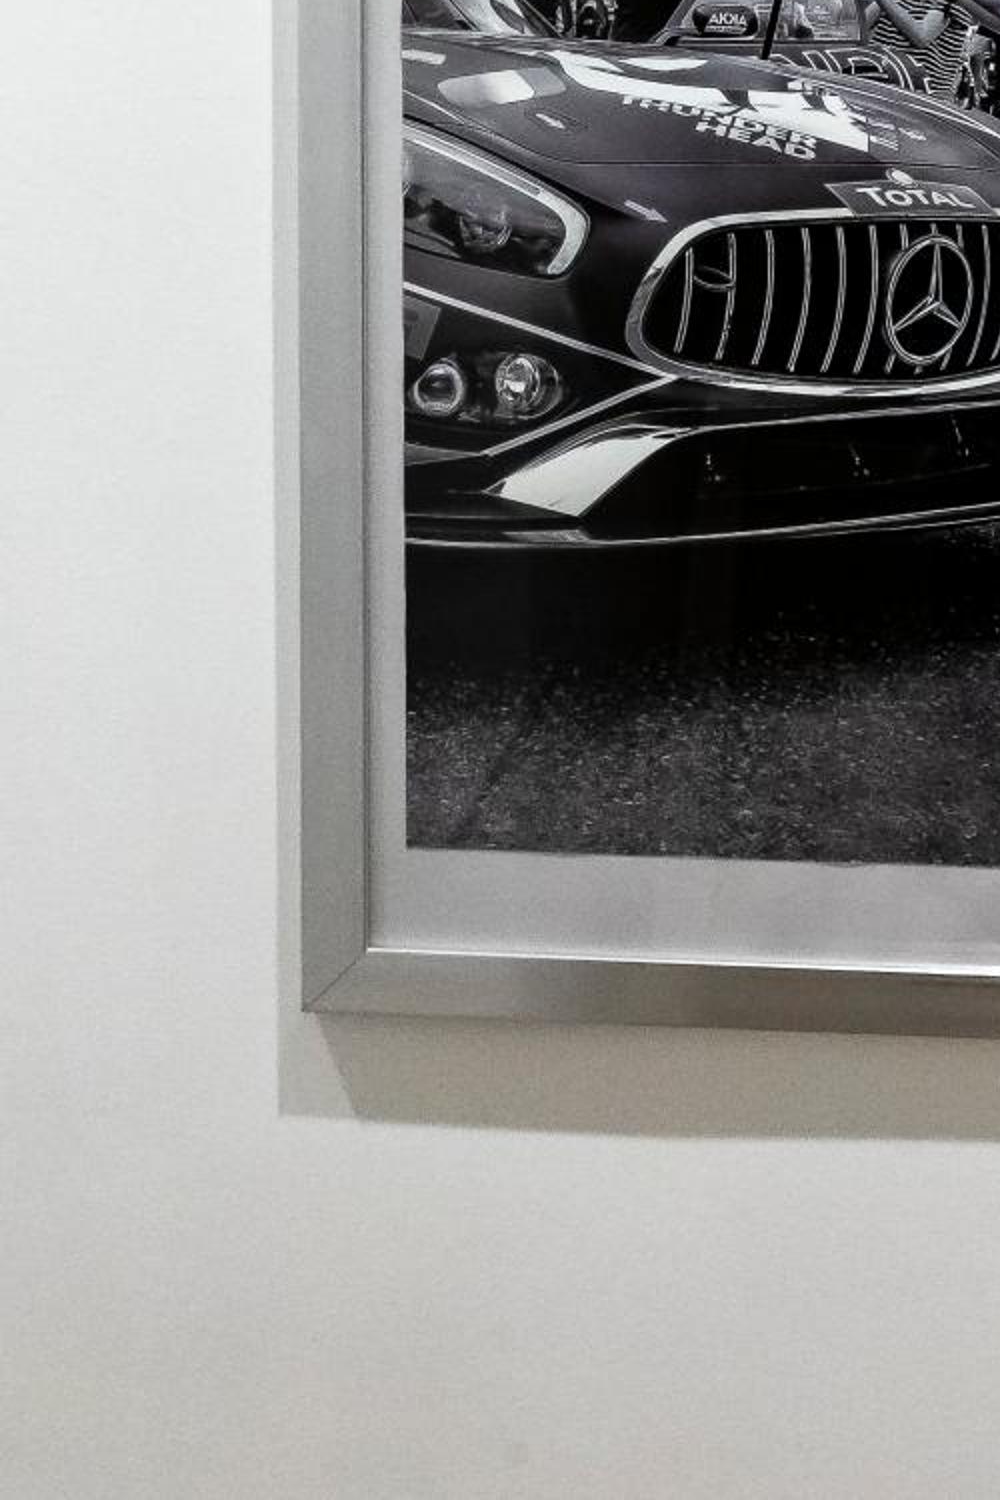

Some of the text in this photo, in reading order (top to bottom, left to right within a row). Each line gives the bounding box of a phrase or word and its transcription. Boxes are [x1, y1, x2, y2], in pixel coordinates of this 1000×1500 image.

[622, 95, 817, 150] THUNDER
[695, 121, 816, 161] HEAD
[856, 187, 976, 208] TOTAL
